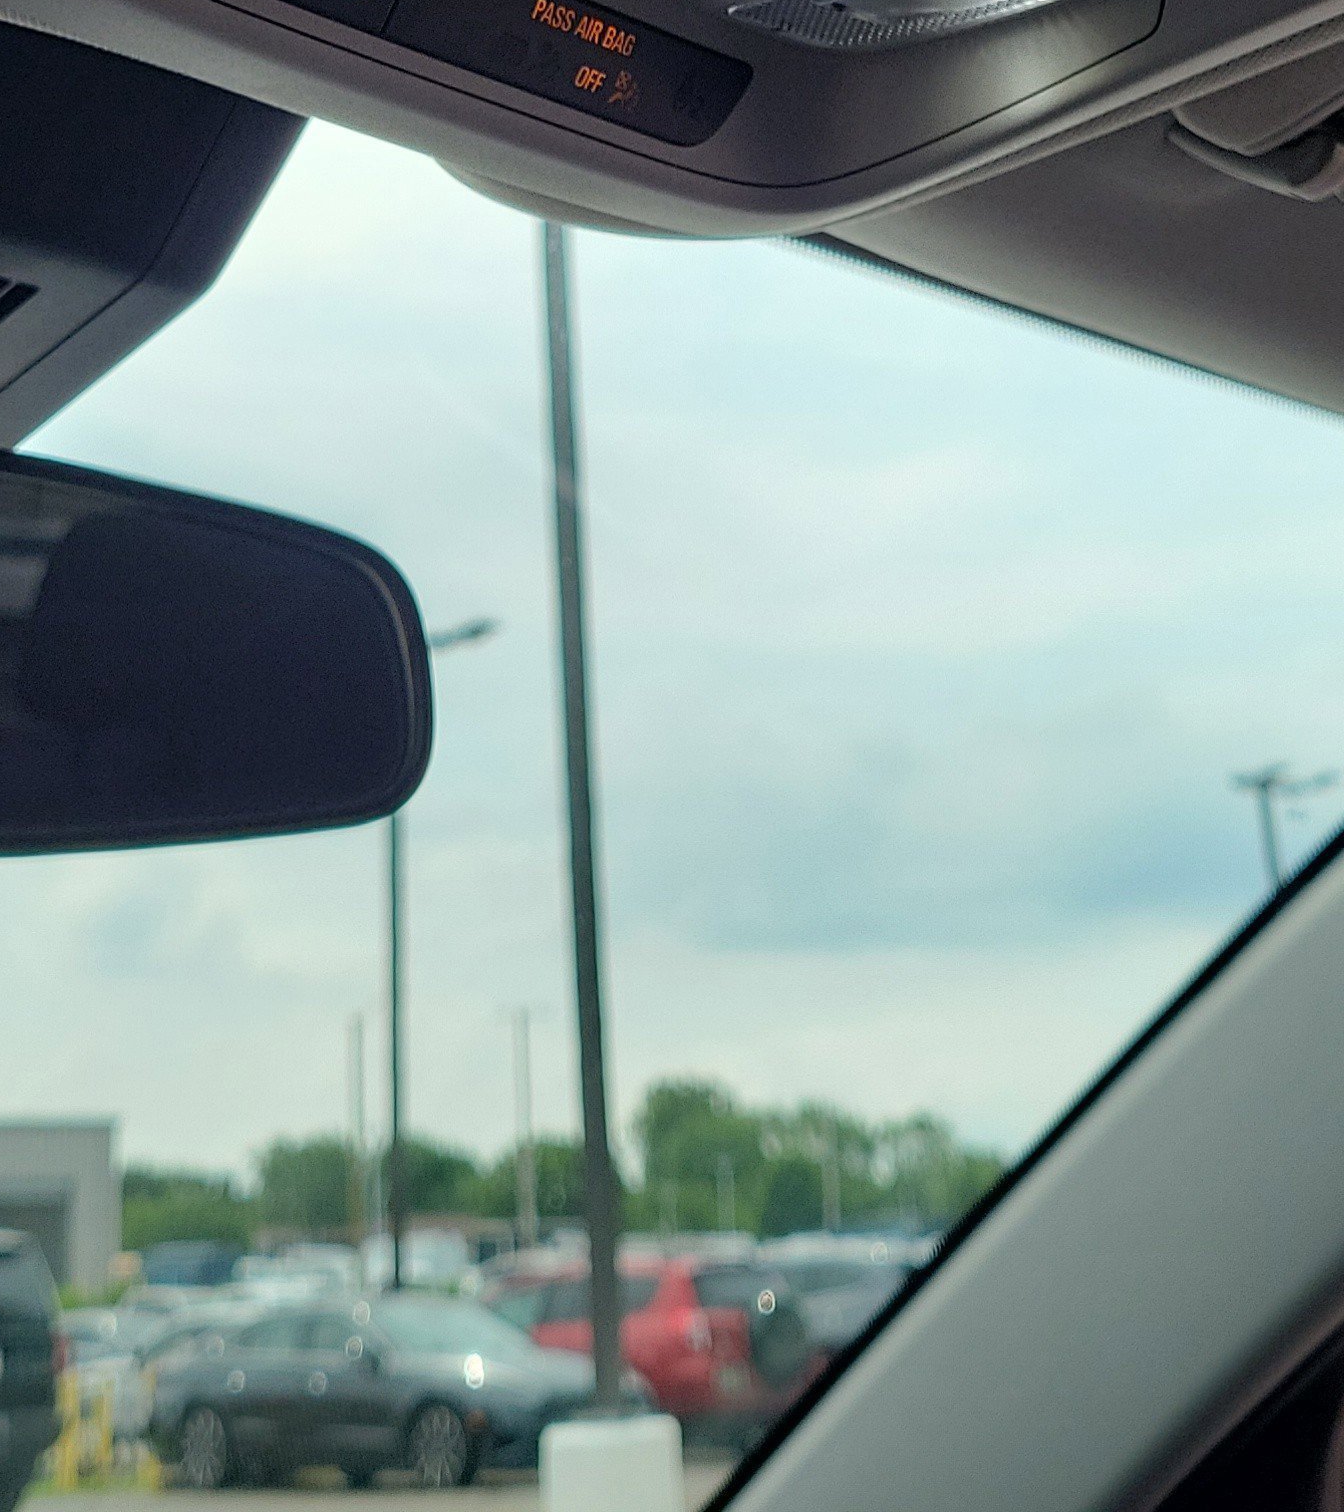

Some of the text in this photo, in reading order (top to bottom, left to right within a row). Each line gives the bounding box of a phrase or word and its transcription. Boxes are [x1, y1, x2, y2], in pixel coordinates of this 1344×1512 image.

[574, 15, 604, 45] AIR
[602, 25, 637, 57] BAG
[574, 65, 607, 94] OFF
